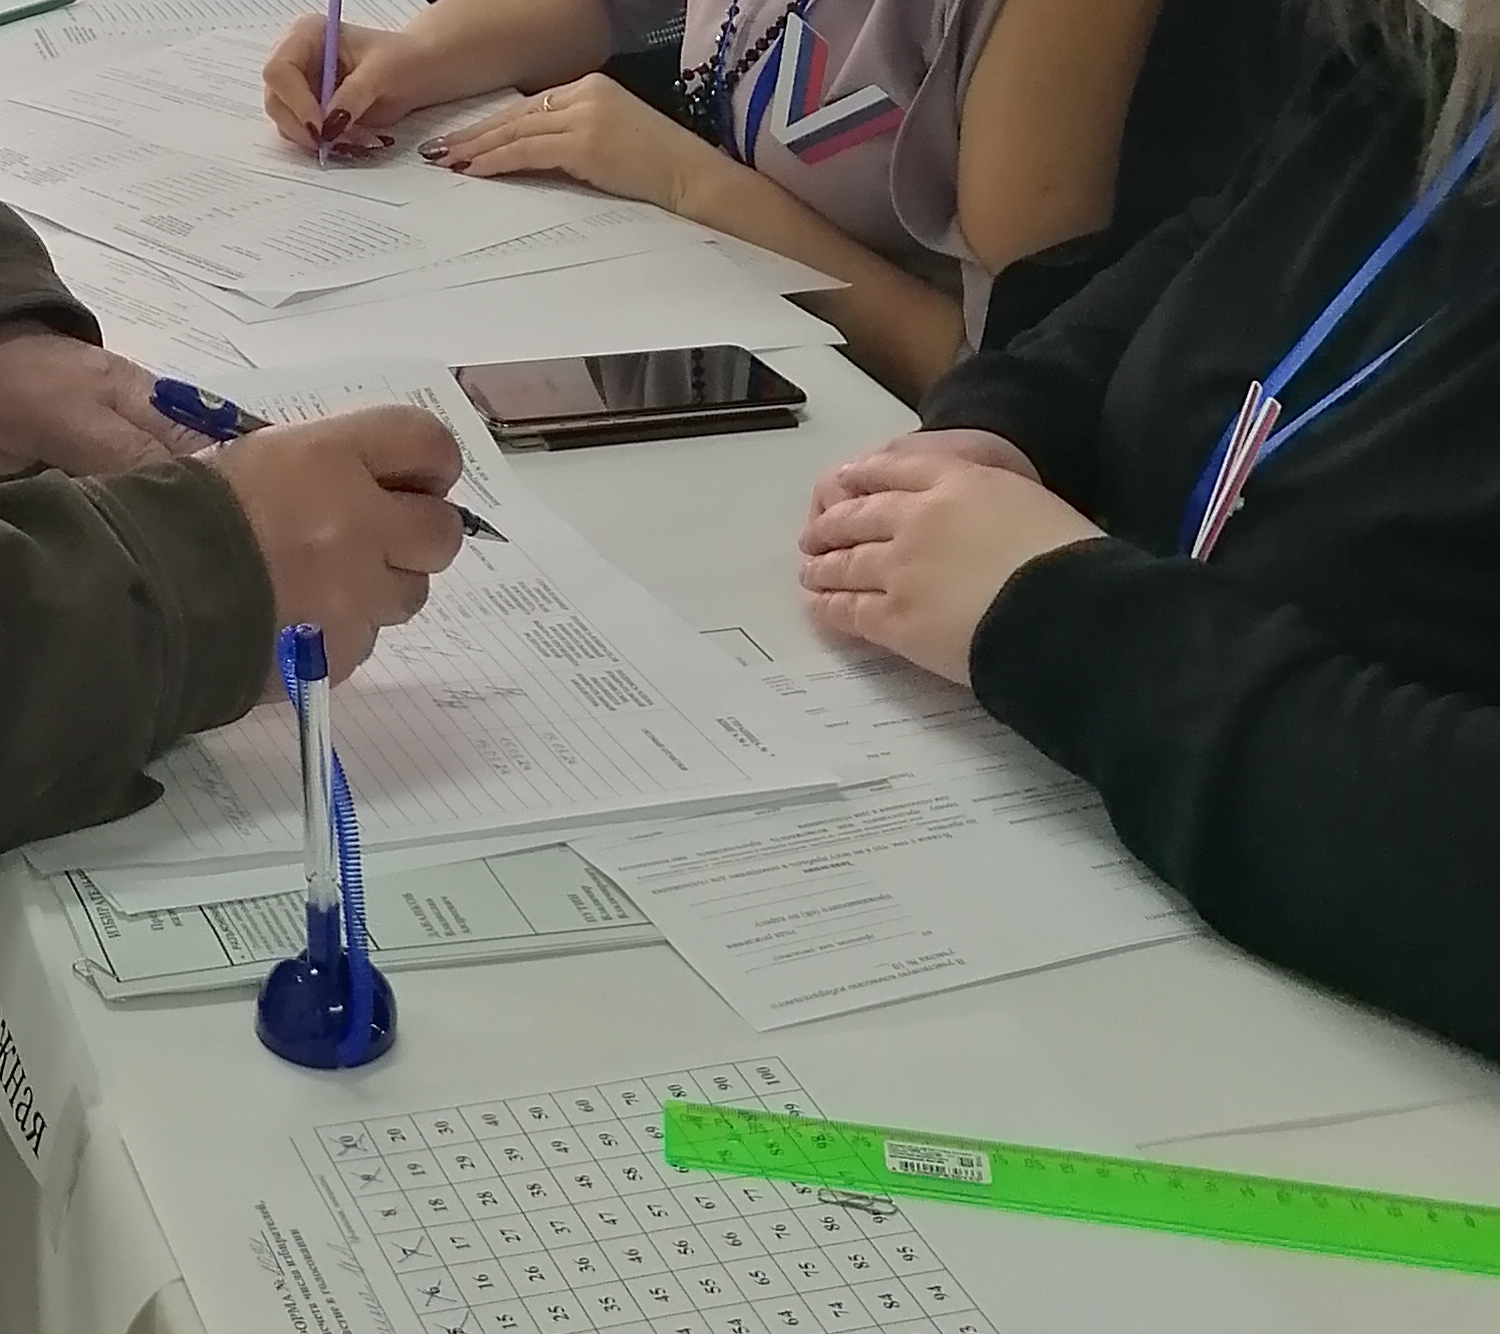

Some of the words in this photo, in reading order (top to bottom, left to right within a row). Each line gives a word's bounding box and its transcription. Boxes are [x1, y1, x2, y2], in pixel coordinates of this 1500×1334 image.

[567, 893, 597, 923] ПУТИН
[712, 1076, 732, 1090] 90
[756, 1066, 780, 1085] 100
[621, 1091, 638, 1105] 70
[667, 1084, 686, 1098] 80
[528, 1106, 548, 1119] 50
[574, 1099, 594, 1112] 60
[784, 1102, 803, 1116] 99
[433, 1120, 454, 1134] 30
[481, 1113, 498, 1126] 40
[386, 1127, 406, 1142] 20
[598, 1132, 618, 1146] 59
[644, 1125, 664, 1139] 69
[503, 1147, 524, 1161] 39
[550, 1140, 569, 1153] 49
[406, 1162, 426, 1176] 19
[455, 1155, 475, 1169] 29
[574, 1174, 592, 1188] 48
[622, 1166, 643, 1181] 58
[526, 1182, 547, 1197] 38
[791, 1179, 811, 1194] 87
[476, 1190, 498, 1206] 28
[694, 1196, 715, 1209] 67
[742, 1188, 762, 1202] 77
[427, 1198, 448, 1212] 18
[646, 1204, 668, 1217] 57
[597, 1212, 617, 1225] 47
[819, 1215, 840, 1231] 86
[549, 1220, 571, 1234] 37
[771, 1223, 790, 1239] 76
[449, 1236, 471, 1249] 17
[498, 1229, 521, 1243] 27
[723, 1231, 742, 1246] 66
[672, 1239, 694, 1255] 56
[895, 1245, 914, 1261] 95
[289, 1228, 331, 1295] голосовании
[624, 1248, 642, 1263] 46
[847, 1253, 869, 1269] 85
[574, 1256, 595, 1272] 36
[797, 1262, 818, 1277] 75
[523, 1265, 545, 1281] 26
[748, 1270, 770, 1285] 65
[290, 1269, 312, 1300] числа
[473, 1273, 494, 1289] 16
[698, 1278, 721, 1294] 55
[648, 1287, 669, 1302] 45
[926, 1285, 947, 1300] 94
[597, 1296, 621, 1312] 35
[877, 1293, 900, 1309] 84
[547, 1305, 569, 1322] 25
[827, 1301, 848, 1318] 74
[495, 1313, 517, 1329] 15
[777, 1309, 798, 1326] 64
[726, 1318, 749, 1334] 54
